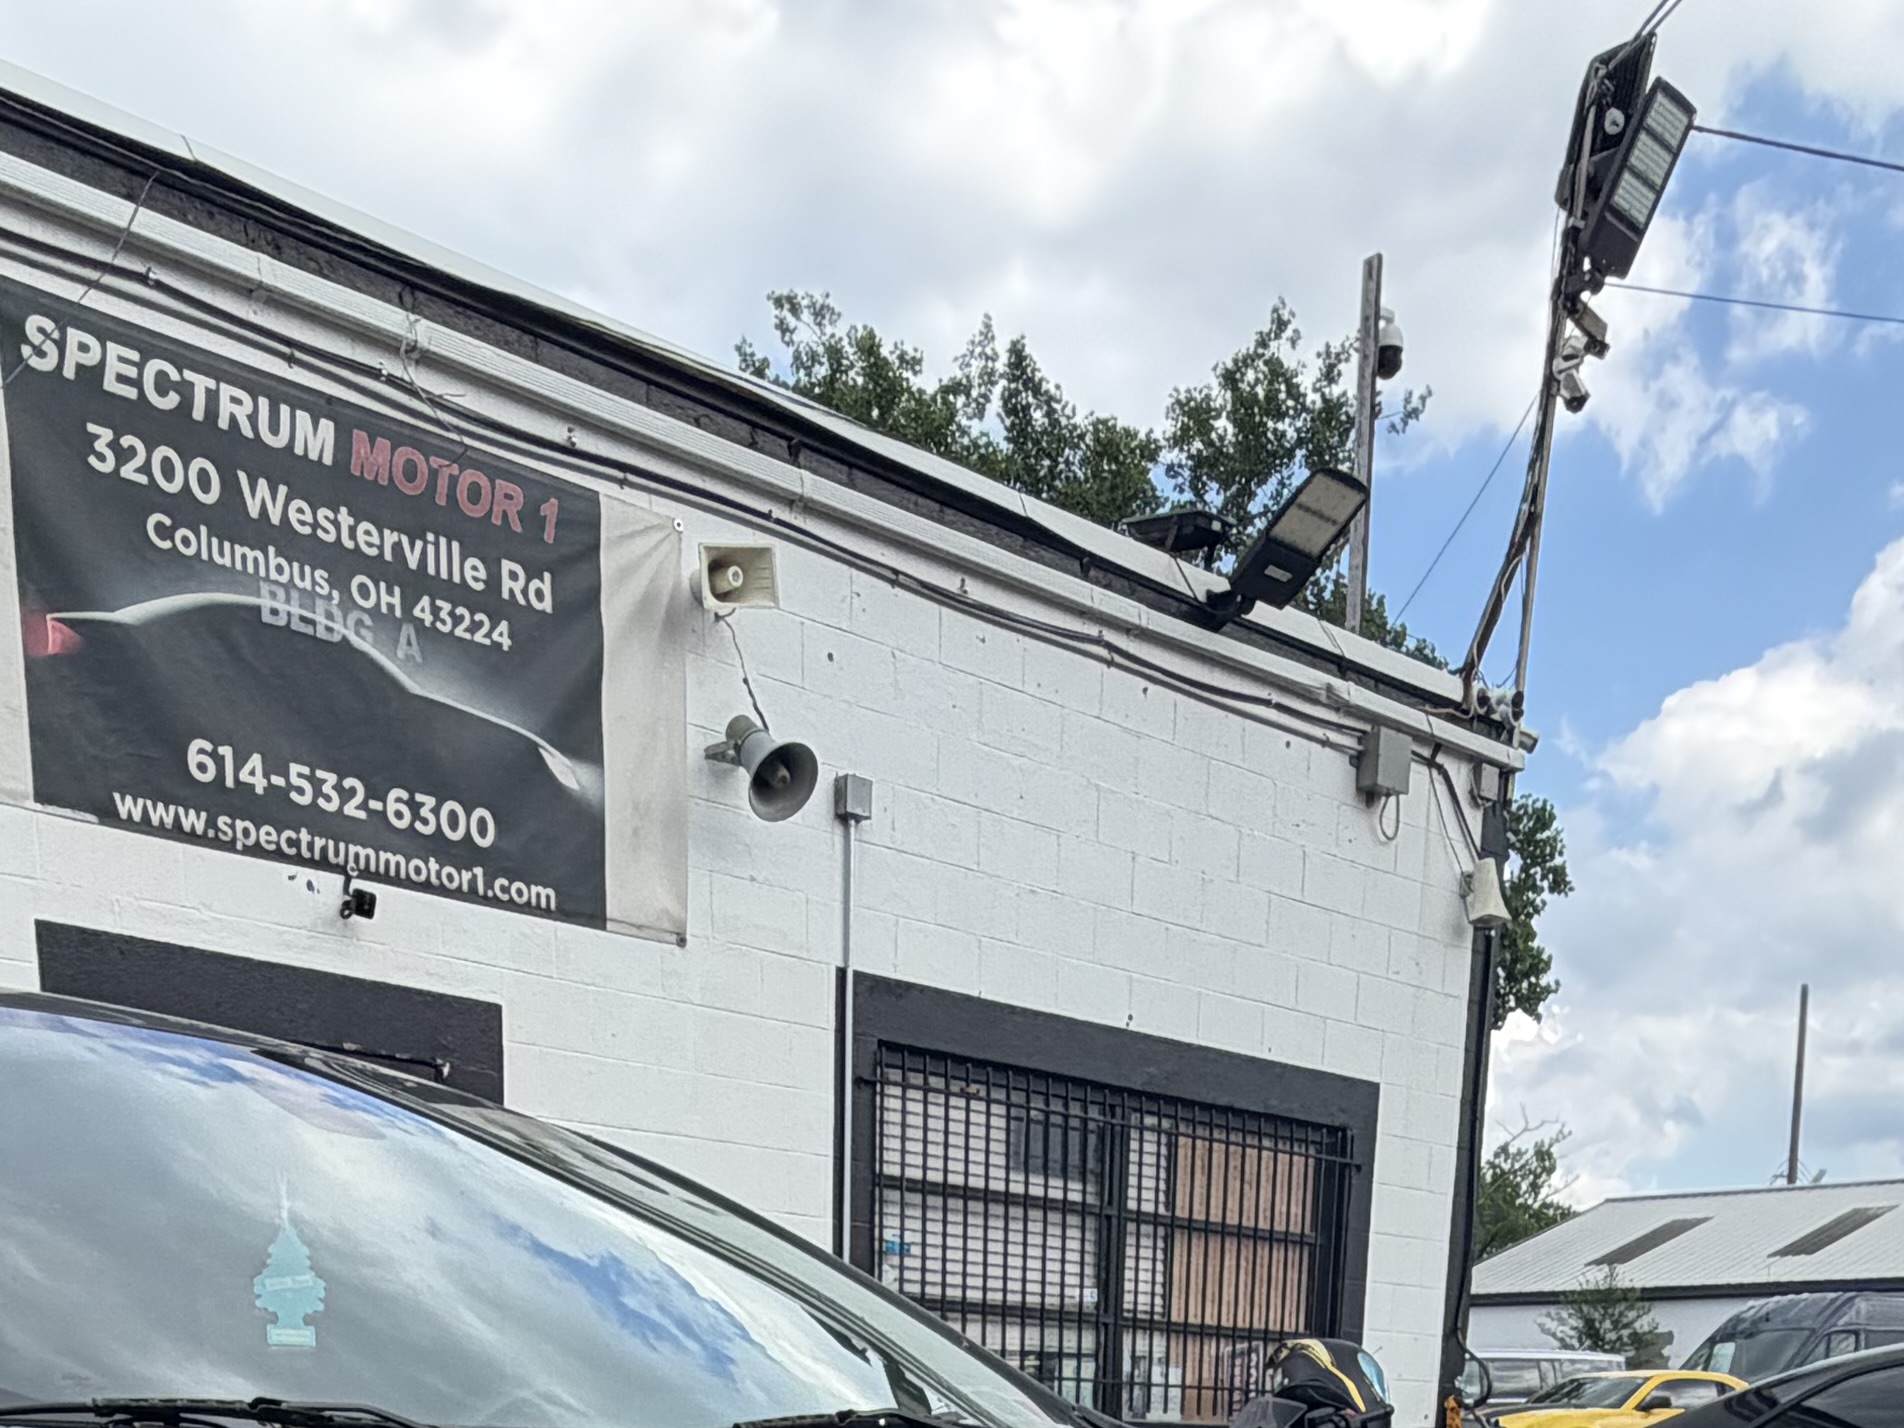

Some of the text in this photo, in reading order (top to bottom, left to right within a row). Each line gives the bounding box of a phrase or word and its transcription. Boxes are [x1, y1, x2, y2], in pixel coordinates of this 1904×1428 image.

[20, 313, 559, 544] SPECTRUM MOTOR 1
[86, 421, 554, 614] 3200 Westerville Rd
[146, 512, 512, 651] Columbus, OH 43224
[259, 580, 423, 664] BLDG A
[112, 791, 557, 911] www.spectrummotor1.com
[186, 737, 496, 848] 614-532-6300
